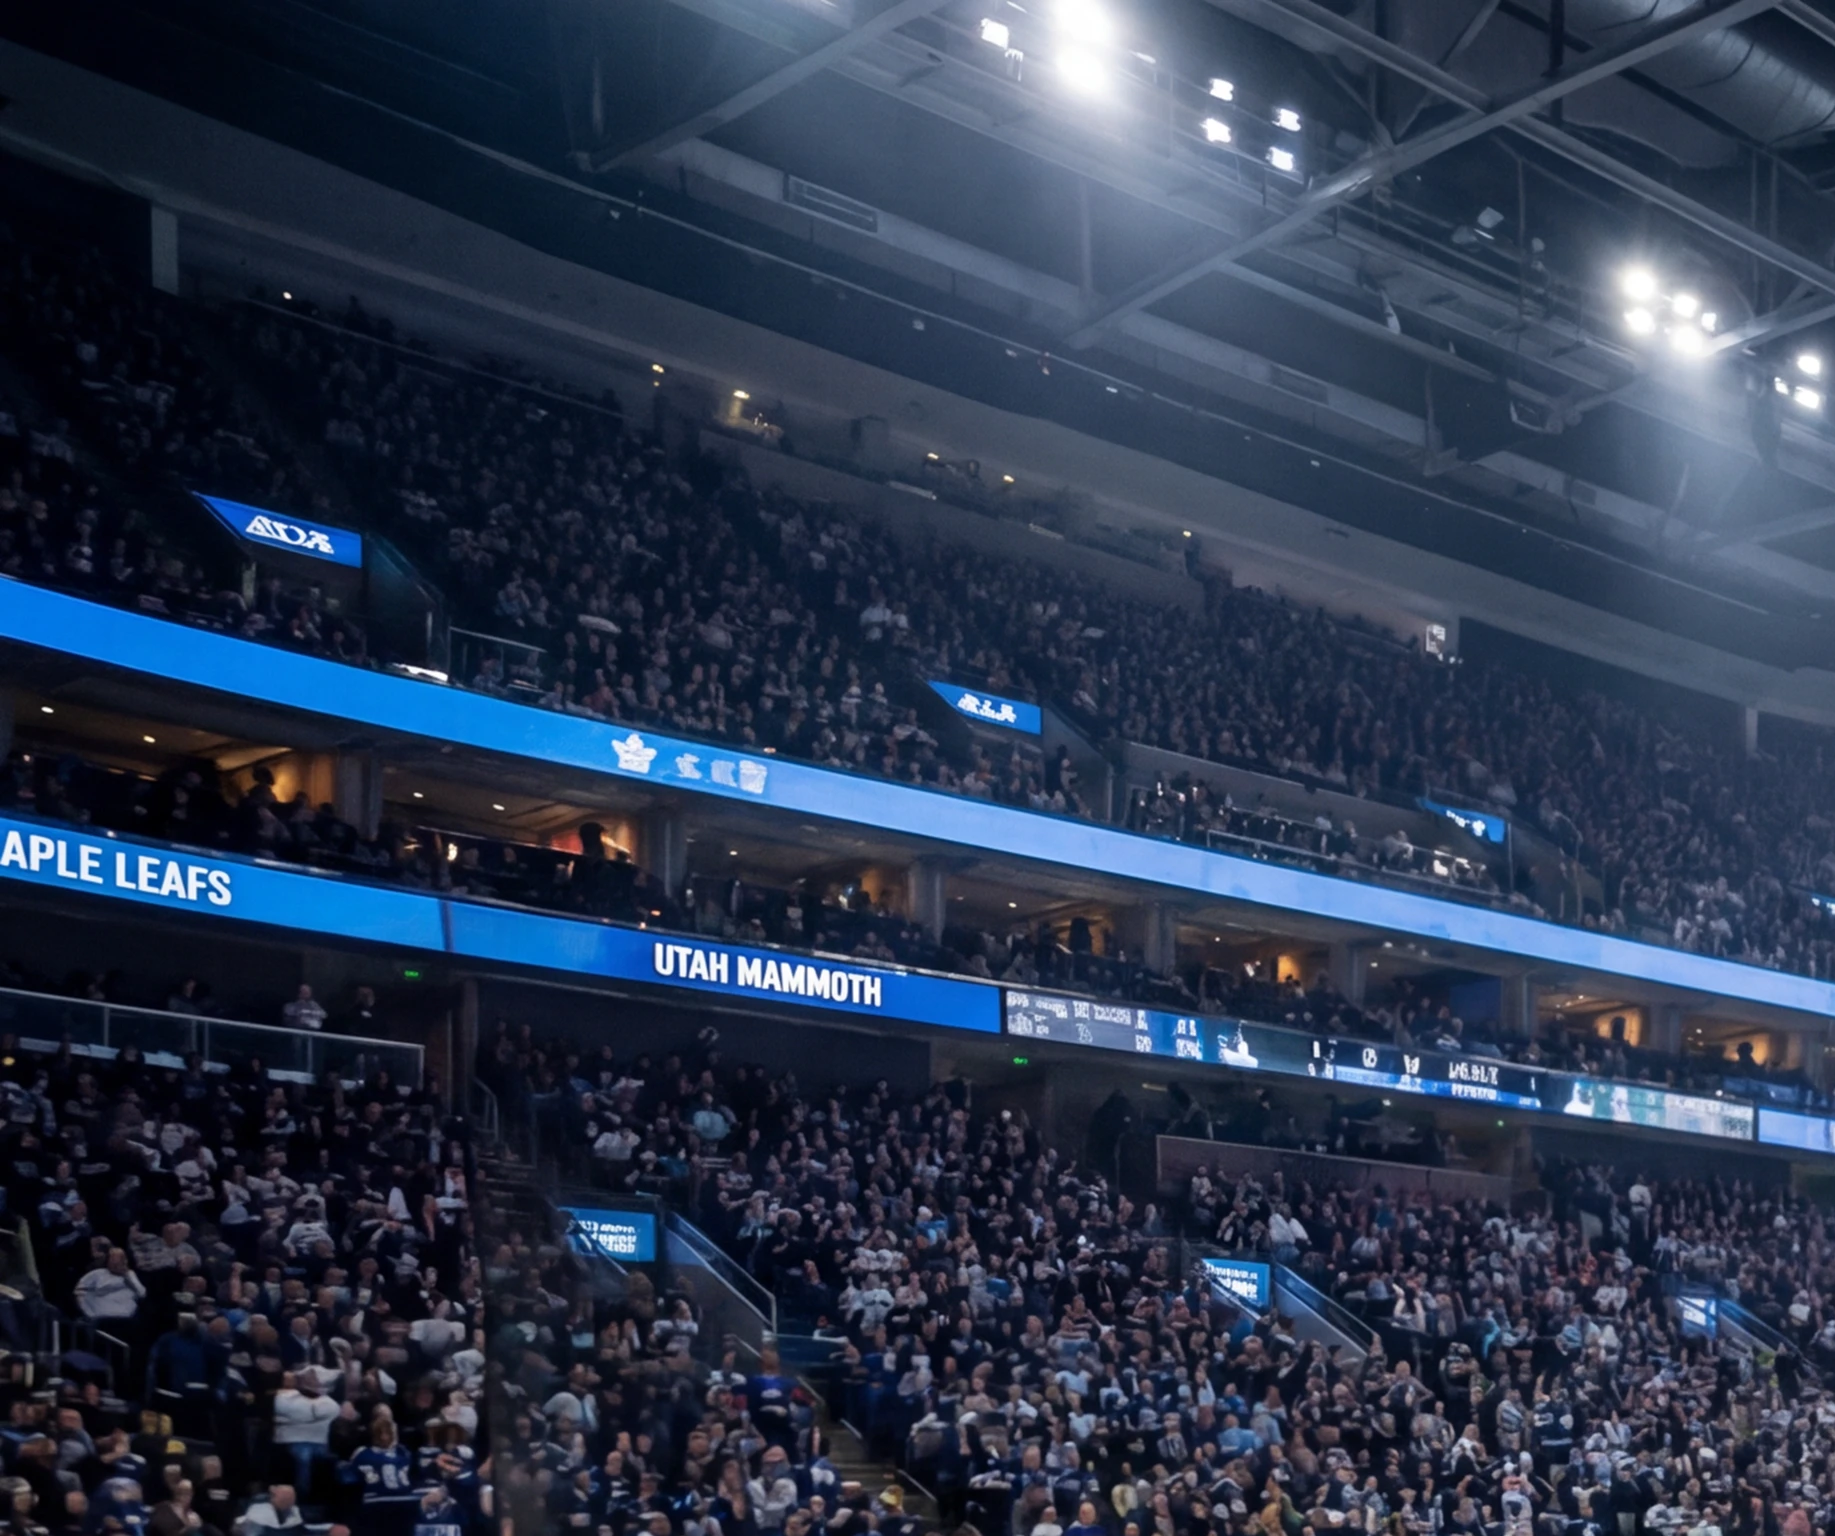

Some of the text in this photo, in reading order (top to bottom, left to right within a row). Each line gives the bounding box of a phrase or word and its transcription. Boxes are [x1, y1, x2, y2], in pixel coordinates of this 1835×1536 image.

[0, 828, 233, 907] APLE LEAFS
[653, 942, 883, 1008] UTAH MAMMOTH
